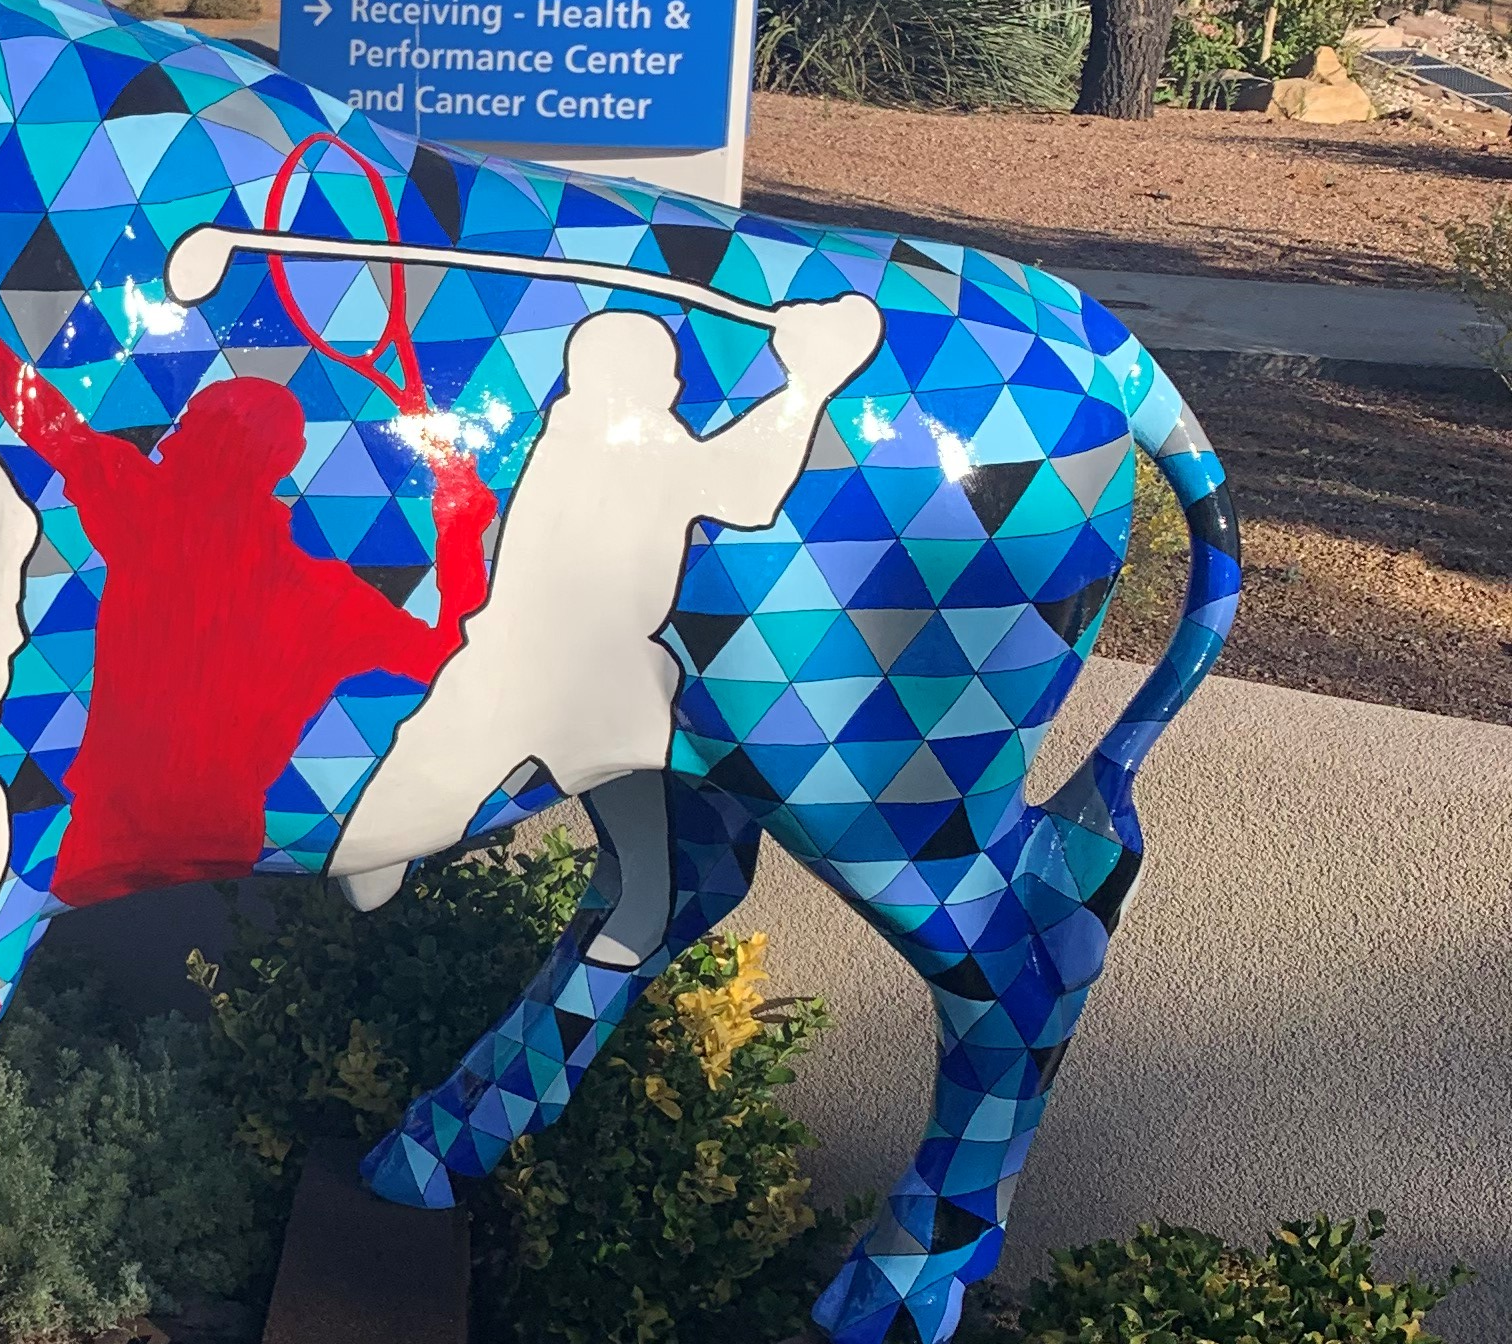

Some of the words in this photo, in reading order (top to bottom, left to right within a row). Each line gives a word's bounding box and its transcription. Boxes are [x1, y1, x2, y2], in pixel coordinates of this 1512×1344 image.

[664, 0, 691, 30] &
[349, 38, 553, 73] Performance
[565, 45, 683, 75] Center
[347, 84, 404, 113] and
[415, 86, 526, 118] Cancer
[536, 89, 652, 120] Center
